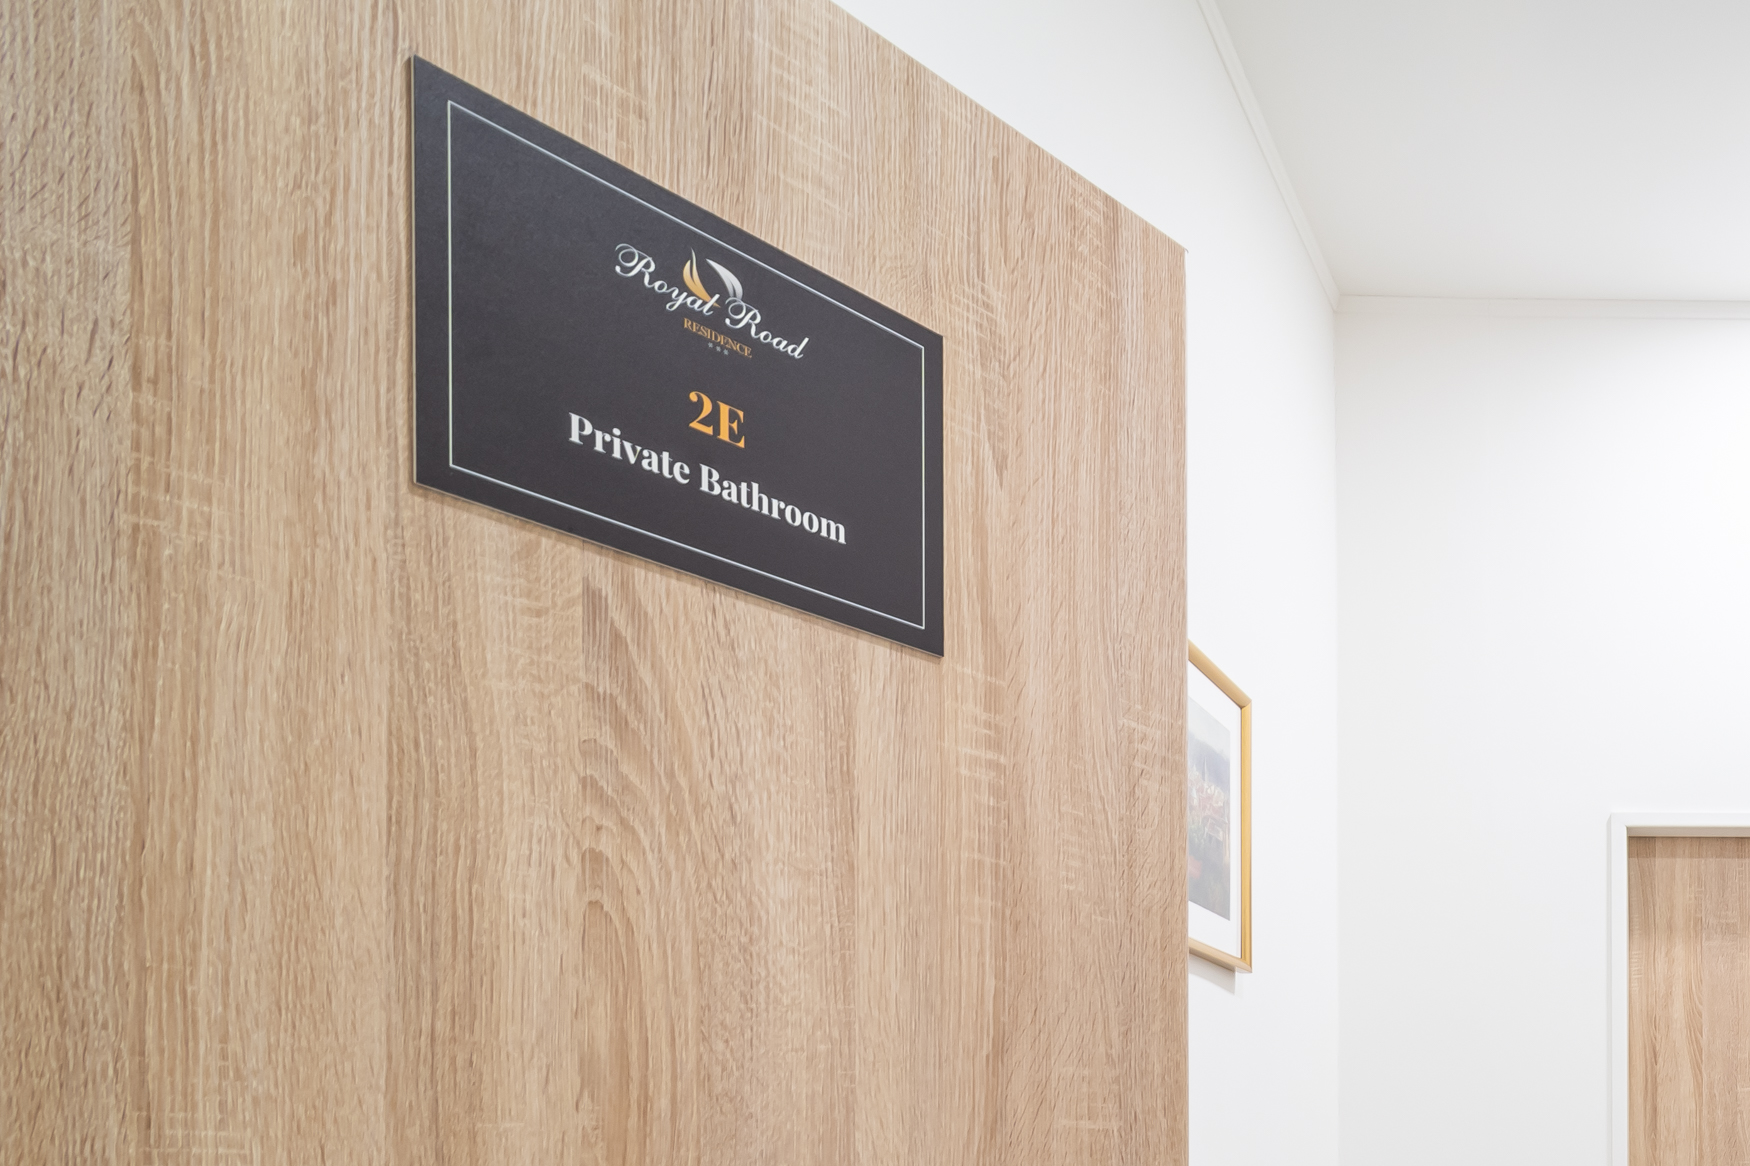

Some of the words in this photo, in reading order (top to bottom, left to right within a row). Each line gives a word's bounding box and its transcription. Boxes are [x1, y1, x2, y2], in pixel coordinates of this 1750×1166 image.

[615, 243, 721, 316] Royal
[724, 296, 810, 360] Road
[683, 317, 753, 359] RESIDENCE
[688, 390, 746, 449] 2E
[568, 411, 691, 485] Private
[699, 462, 847, 545] Bathroom
